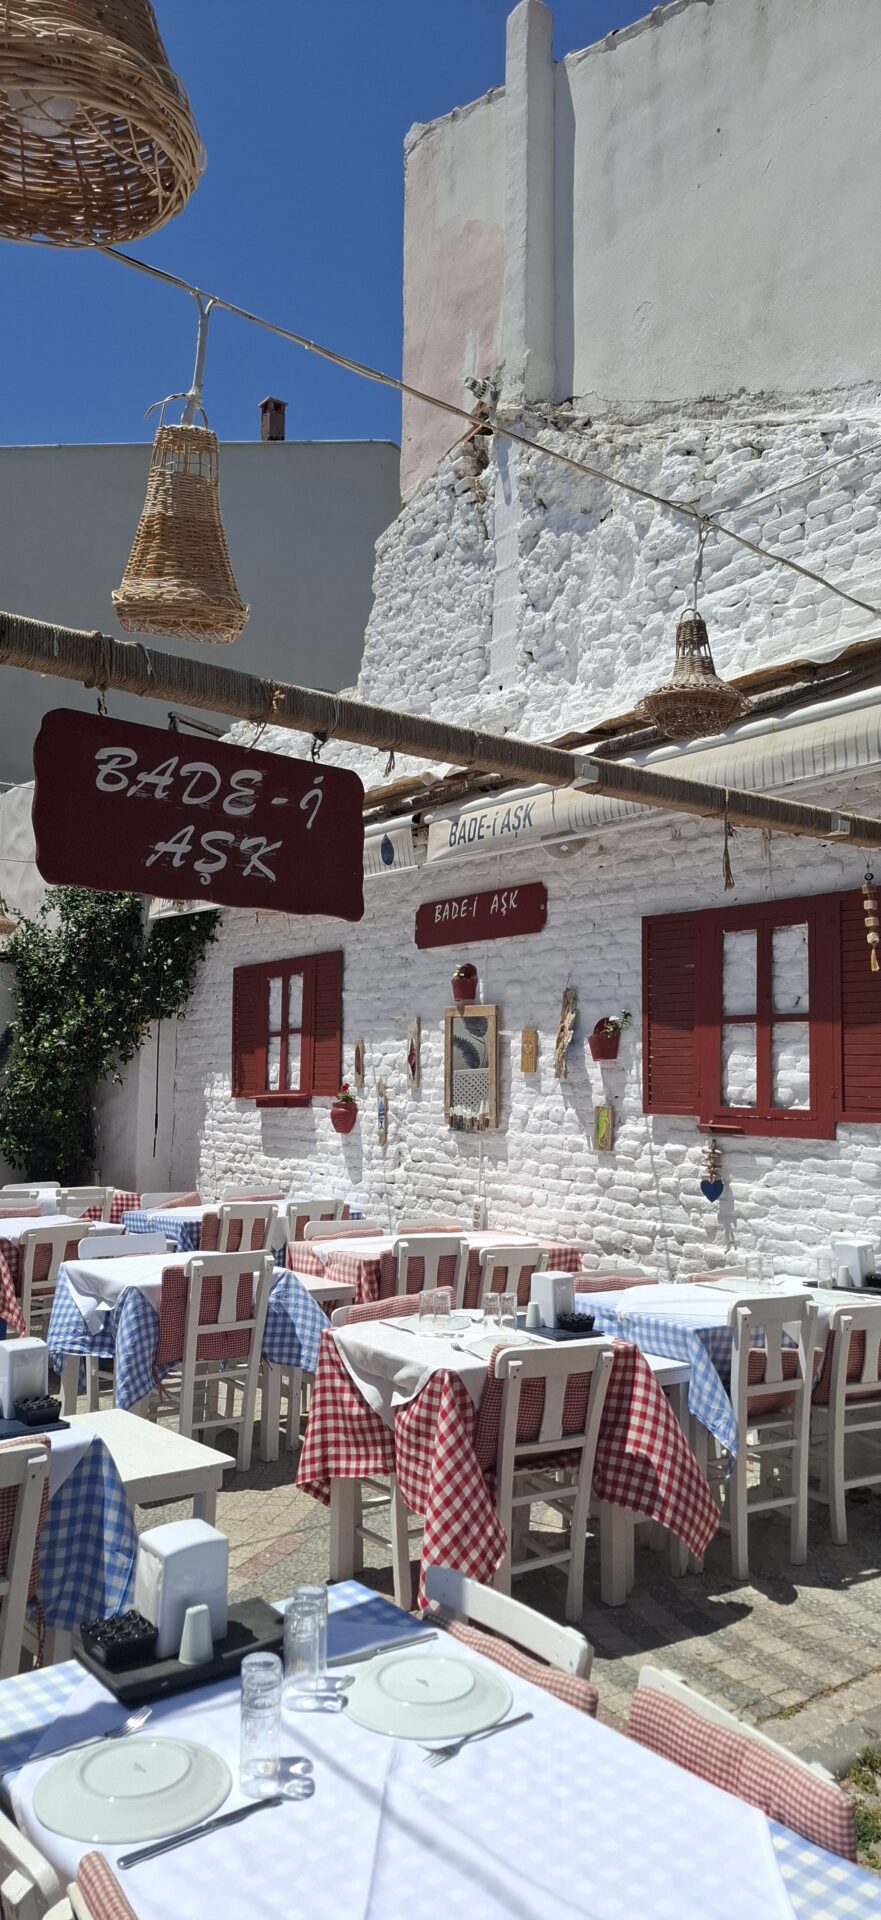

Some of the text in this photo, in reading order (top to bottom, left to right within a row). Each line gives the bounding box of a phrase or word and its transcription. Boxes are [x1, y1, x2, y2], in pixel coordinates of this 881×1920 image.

[500, 801, 536, 838] AŞK
[145, 825, 283, 885] AŞK
[490, 889, 519, 916] AŞK
